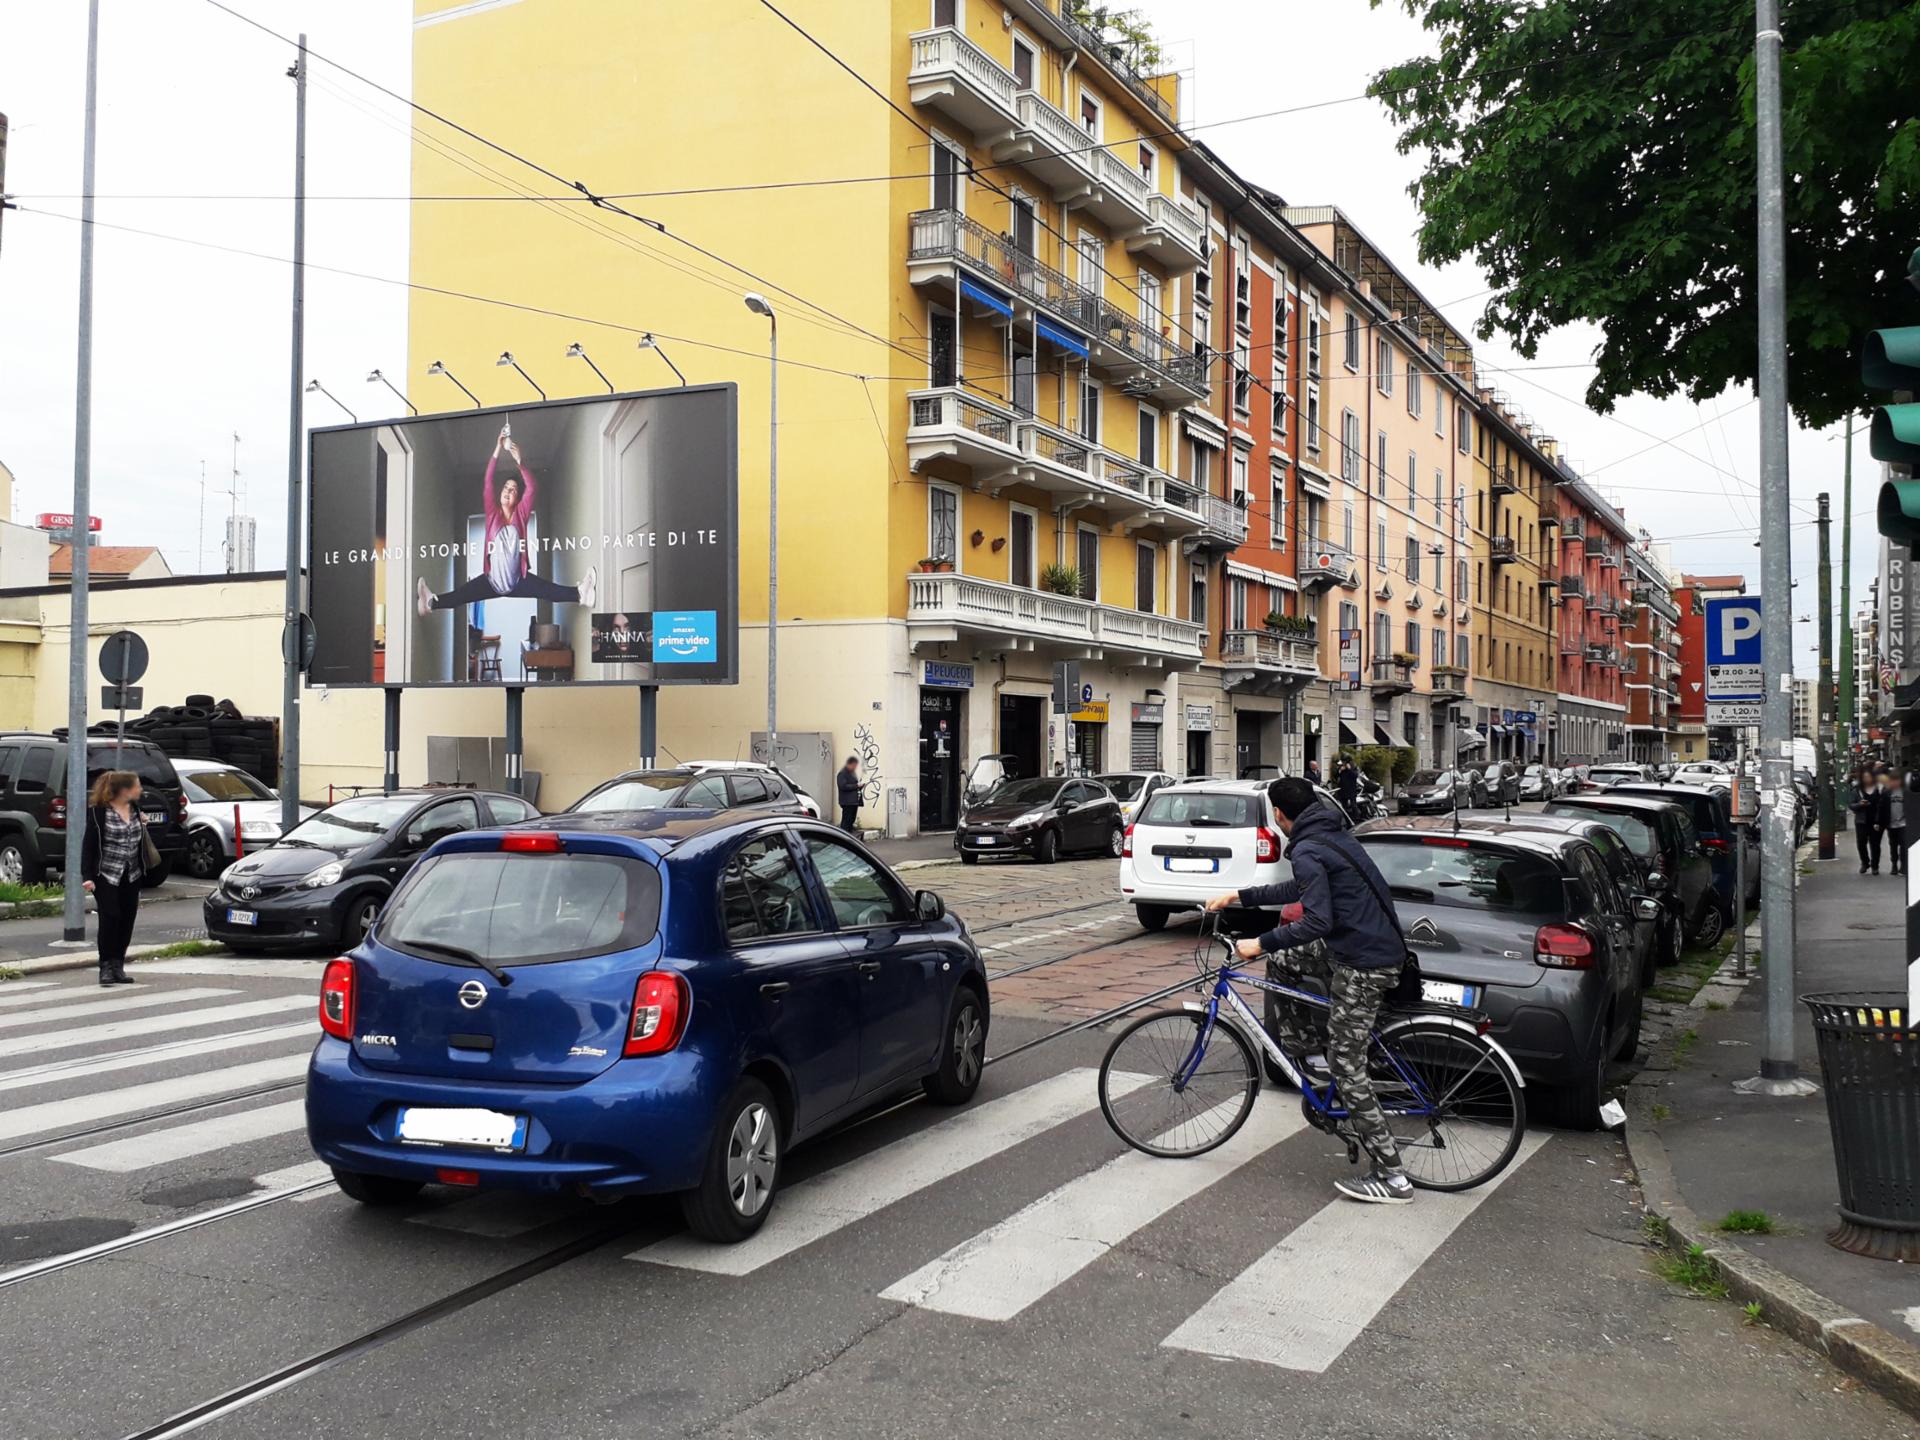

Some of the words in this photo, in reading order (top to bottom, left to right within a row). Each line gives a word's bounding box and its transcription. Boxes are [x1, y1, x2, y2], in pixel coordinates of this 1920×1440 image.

[325, 551, 339, 565] LE
[348, 546, 410, 563] GRANDI
[419, 542, 477, 559] STORIE
[487, 535, 592, 554] DIVENTANO
[603, 532, 657, 548] PARTE
[668, 531, 686, 546] DI
[697, 530, 717, 544] TE
[1889, 559, 1904, 664] RUBENS
[600, 631, 646, 643] HANNA
[1721, 607, 1761, 656] P
[659, 635, 685, 648] prime
[685, 636, 710, 646] video
[934, 664, 971, 679] PEUGEOT
[361, 1034, 397, 1046] MICRA
